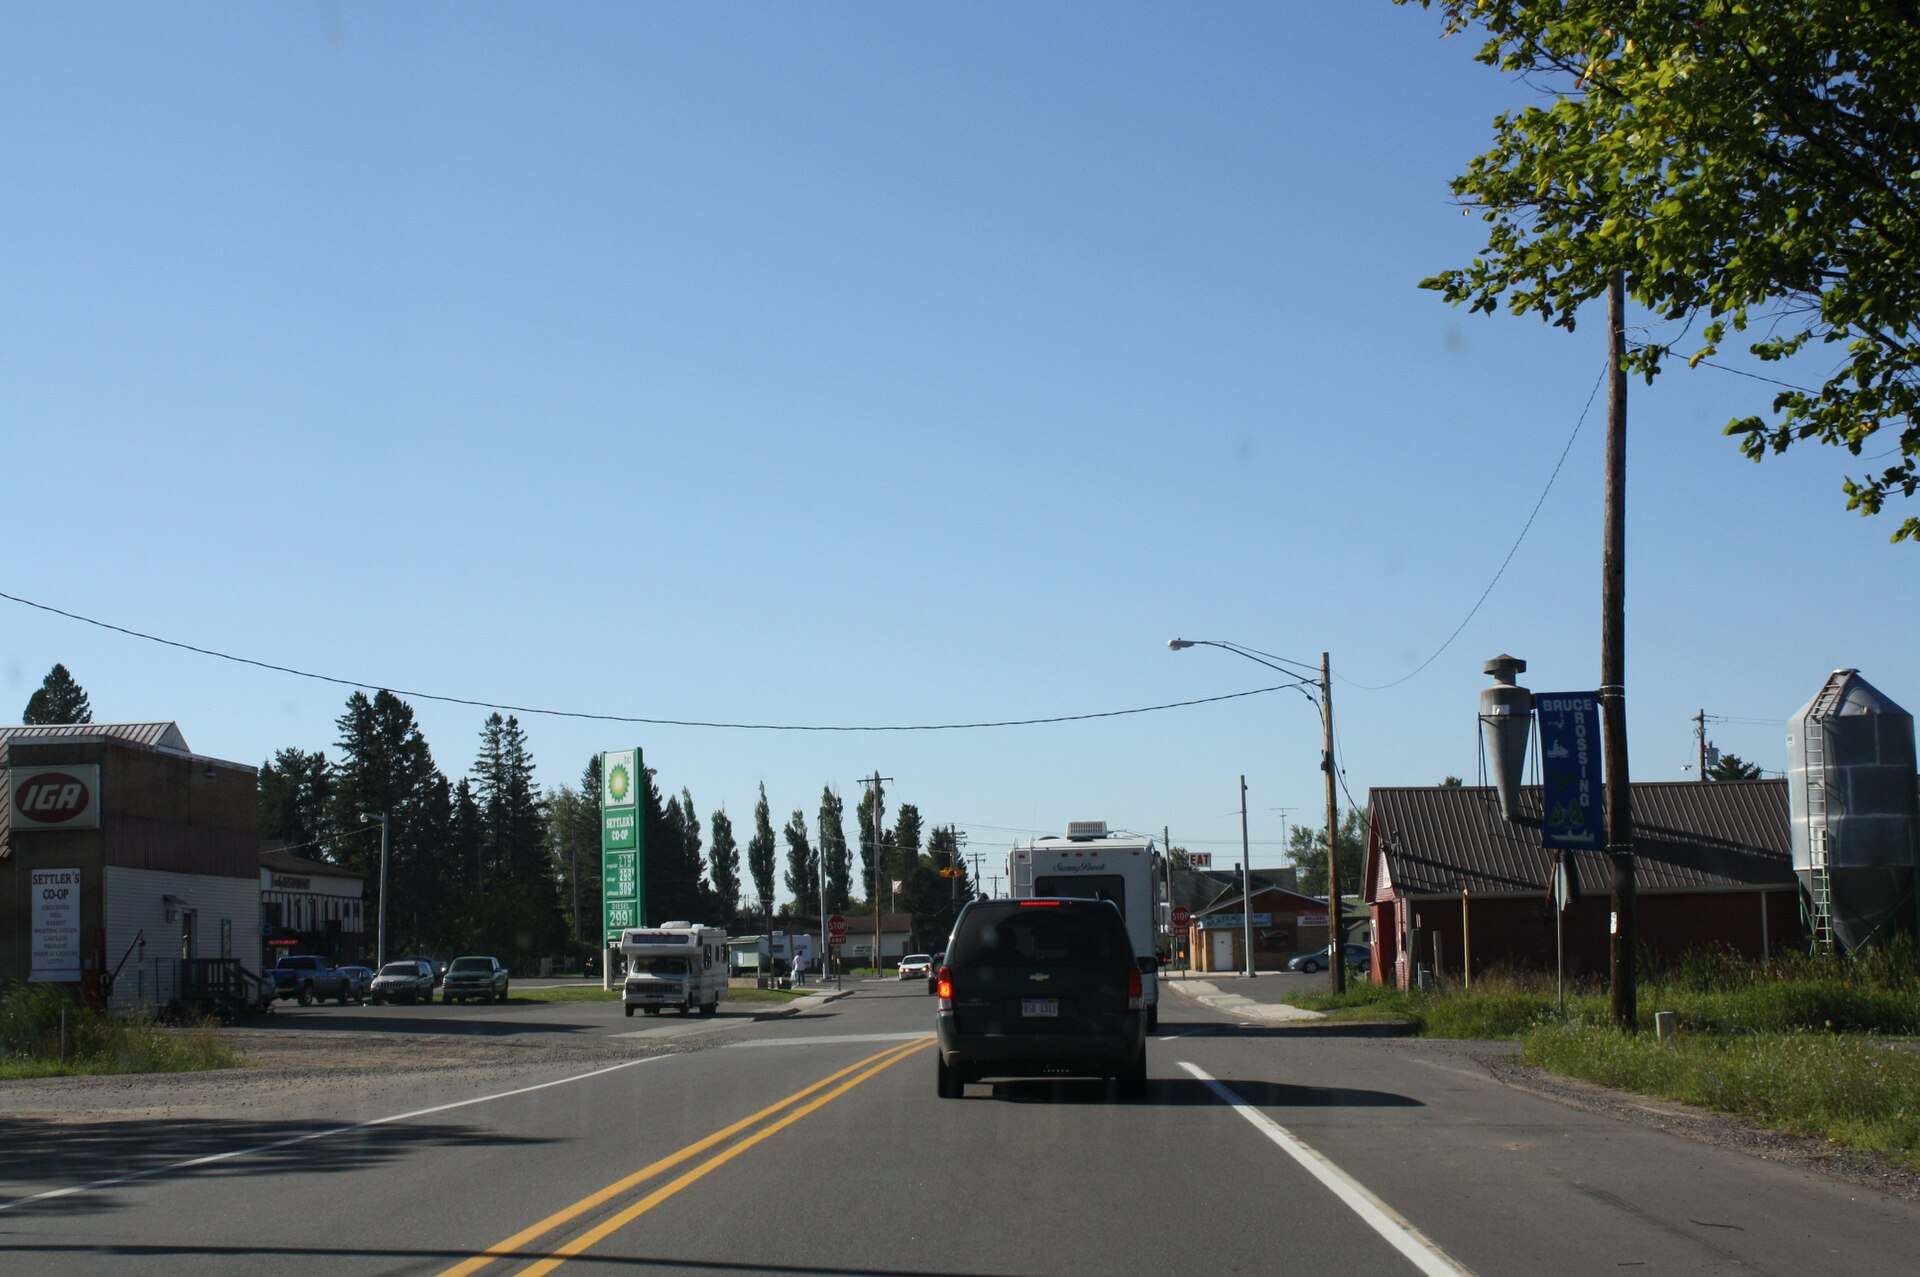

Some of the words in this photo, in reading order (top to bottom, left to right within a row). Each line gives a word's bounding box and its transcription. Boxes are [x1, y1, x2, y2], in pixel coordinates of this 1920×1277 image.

[1542, 699, 1593, 712] BRUCE
[22, 784, 81, 810] IGA
[606, 813, 634, 828] SETTLER'S
[611, 830, 629, 841] CO-OP
[1191, 854, 1209, 864] EAT
[32, 871, 80, 885] SETTLER'S
[42, 889, 69, 900] CO-OP
[1172, 912, 1189, 920] STOP
[829, 922, 846, 930] STOP
